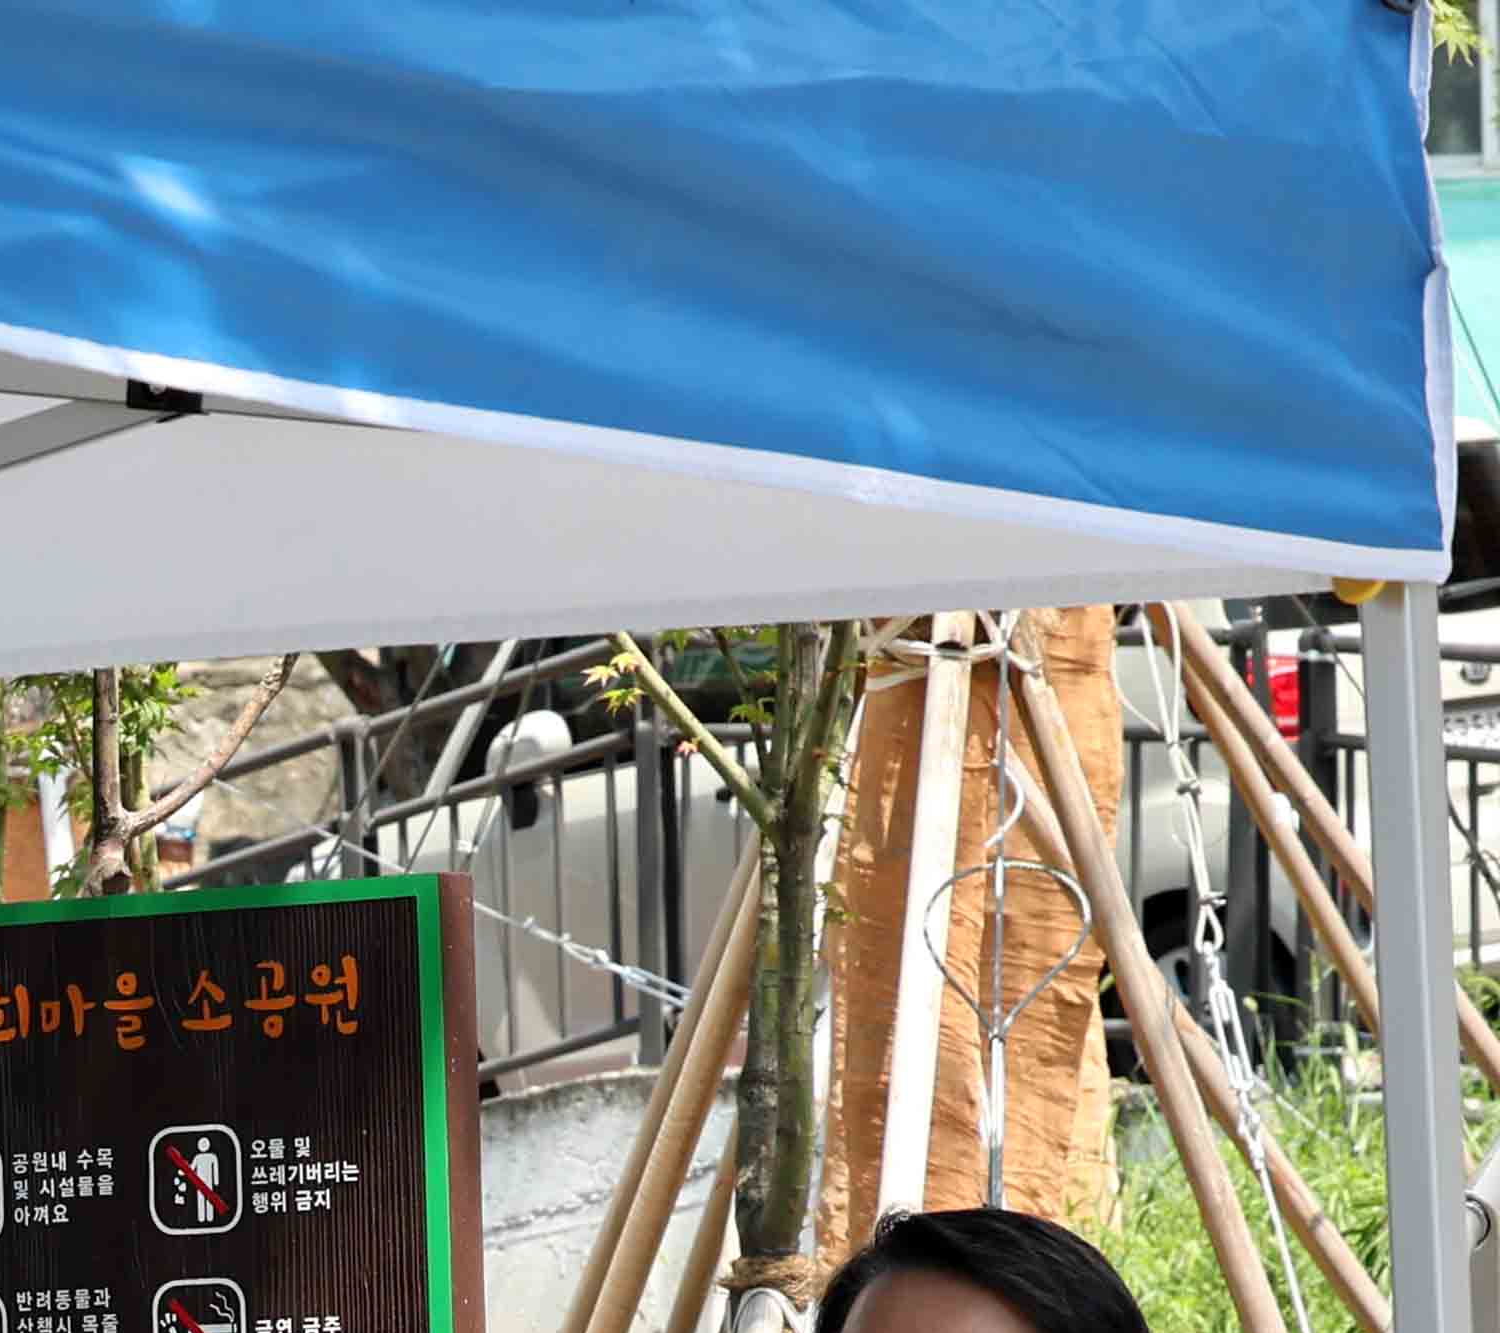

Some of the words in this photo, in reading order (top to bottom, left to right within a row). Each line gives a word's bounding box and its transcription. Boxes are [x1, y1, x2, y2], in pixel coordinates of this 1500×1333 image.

[183, 955, 358, 1037] 소공원
[250, 1138, 285, 1160] 오물
[294, 1135, 311, 1158] 및
[12, 1150, 67, 1174] 공원내
[76, 1148, 114, 1171] 수목
[251, 1160, 360, 1186] 쓰레기버리는
[13, 1179, 29, 1200] 및
[39, 1174, 114, 1198] 시설물을
[252, 1190, 287, 1214] 행위
[294, 1188, 331, 1212] 금지
[14, 1203, 69, 1227] 아껴요
[16, 1287, 111, 1312] 반려동물과
